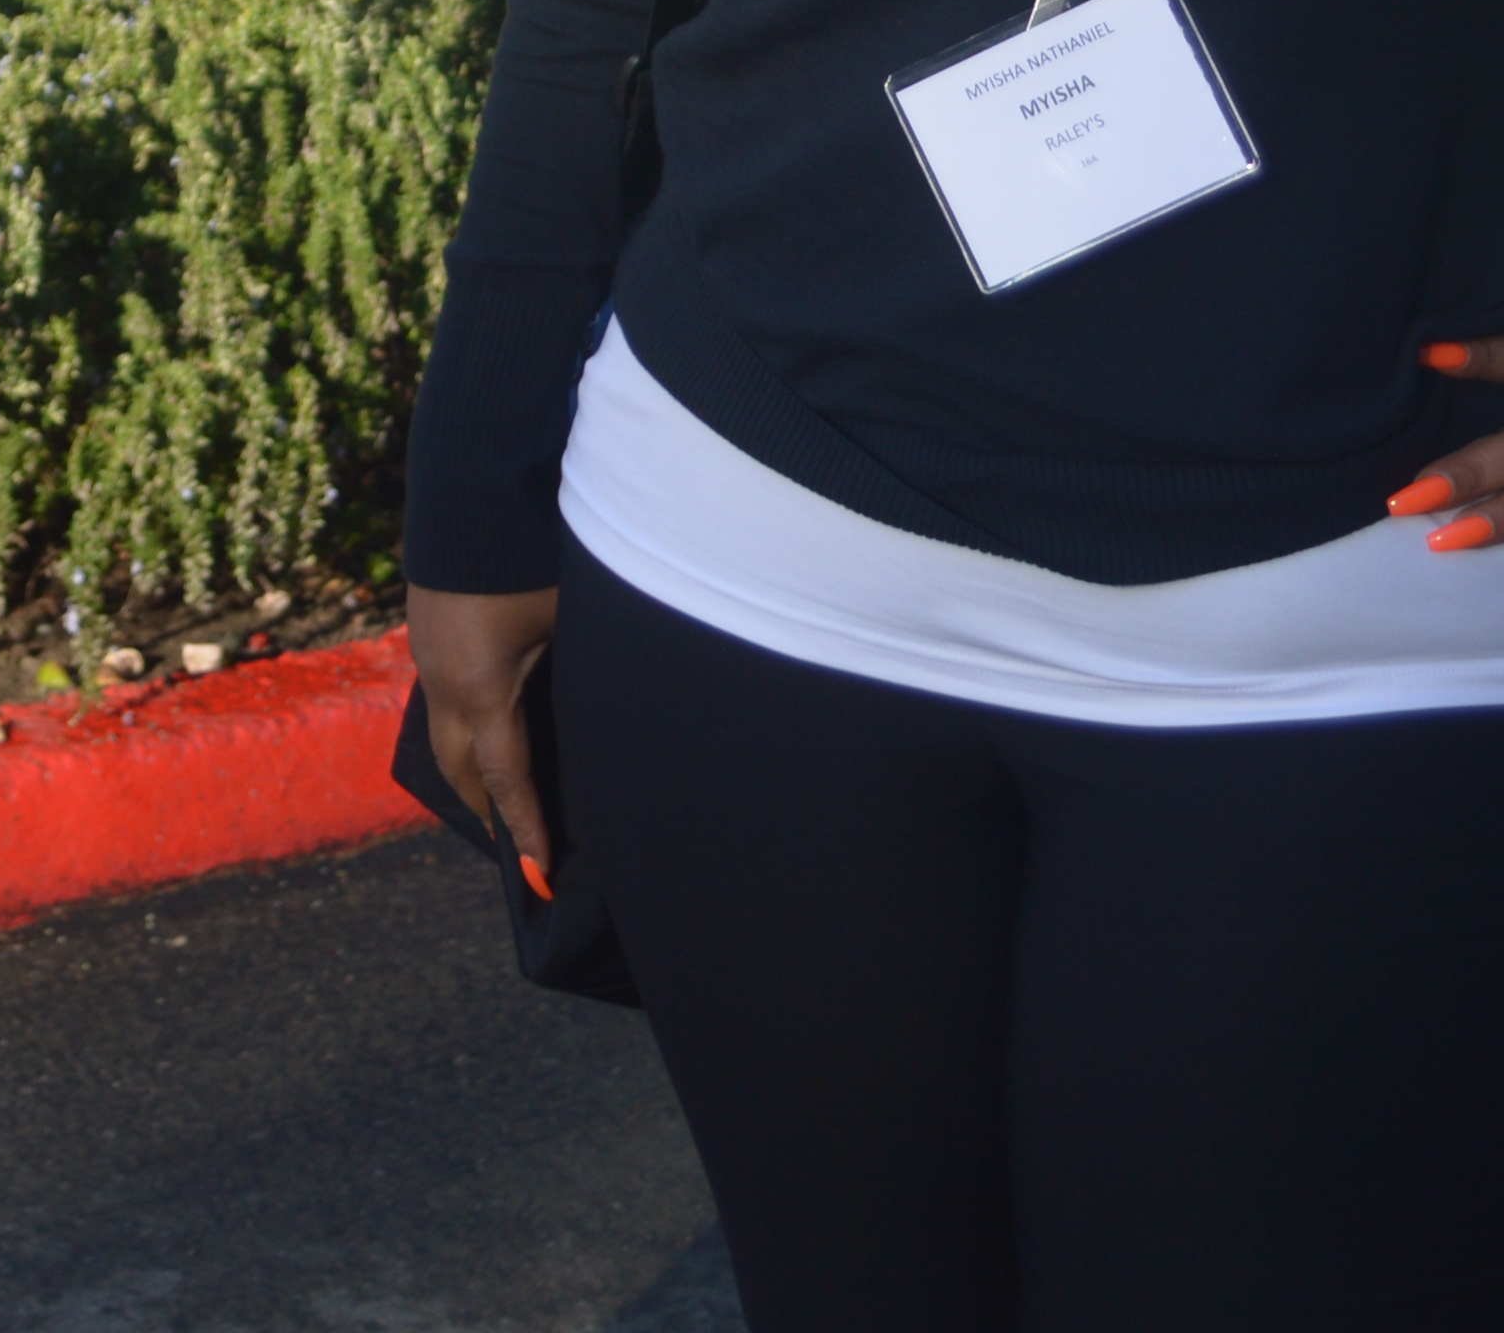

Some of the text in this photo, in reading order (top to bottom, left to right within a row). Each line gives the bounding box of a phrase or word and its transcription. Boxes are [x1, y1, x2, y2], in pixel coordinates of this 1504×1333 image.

[964, 21, 1115, 101] MYISHA NATHANIEL
[1019, 74, 1096, 121] MYISHA
[1044, 113, 1105, 151] RALEY'S
